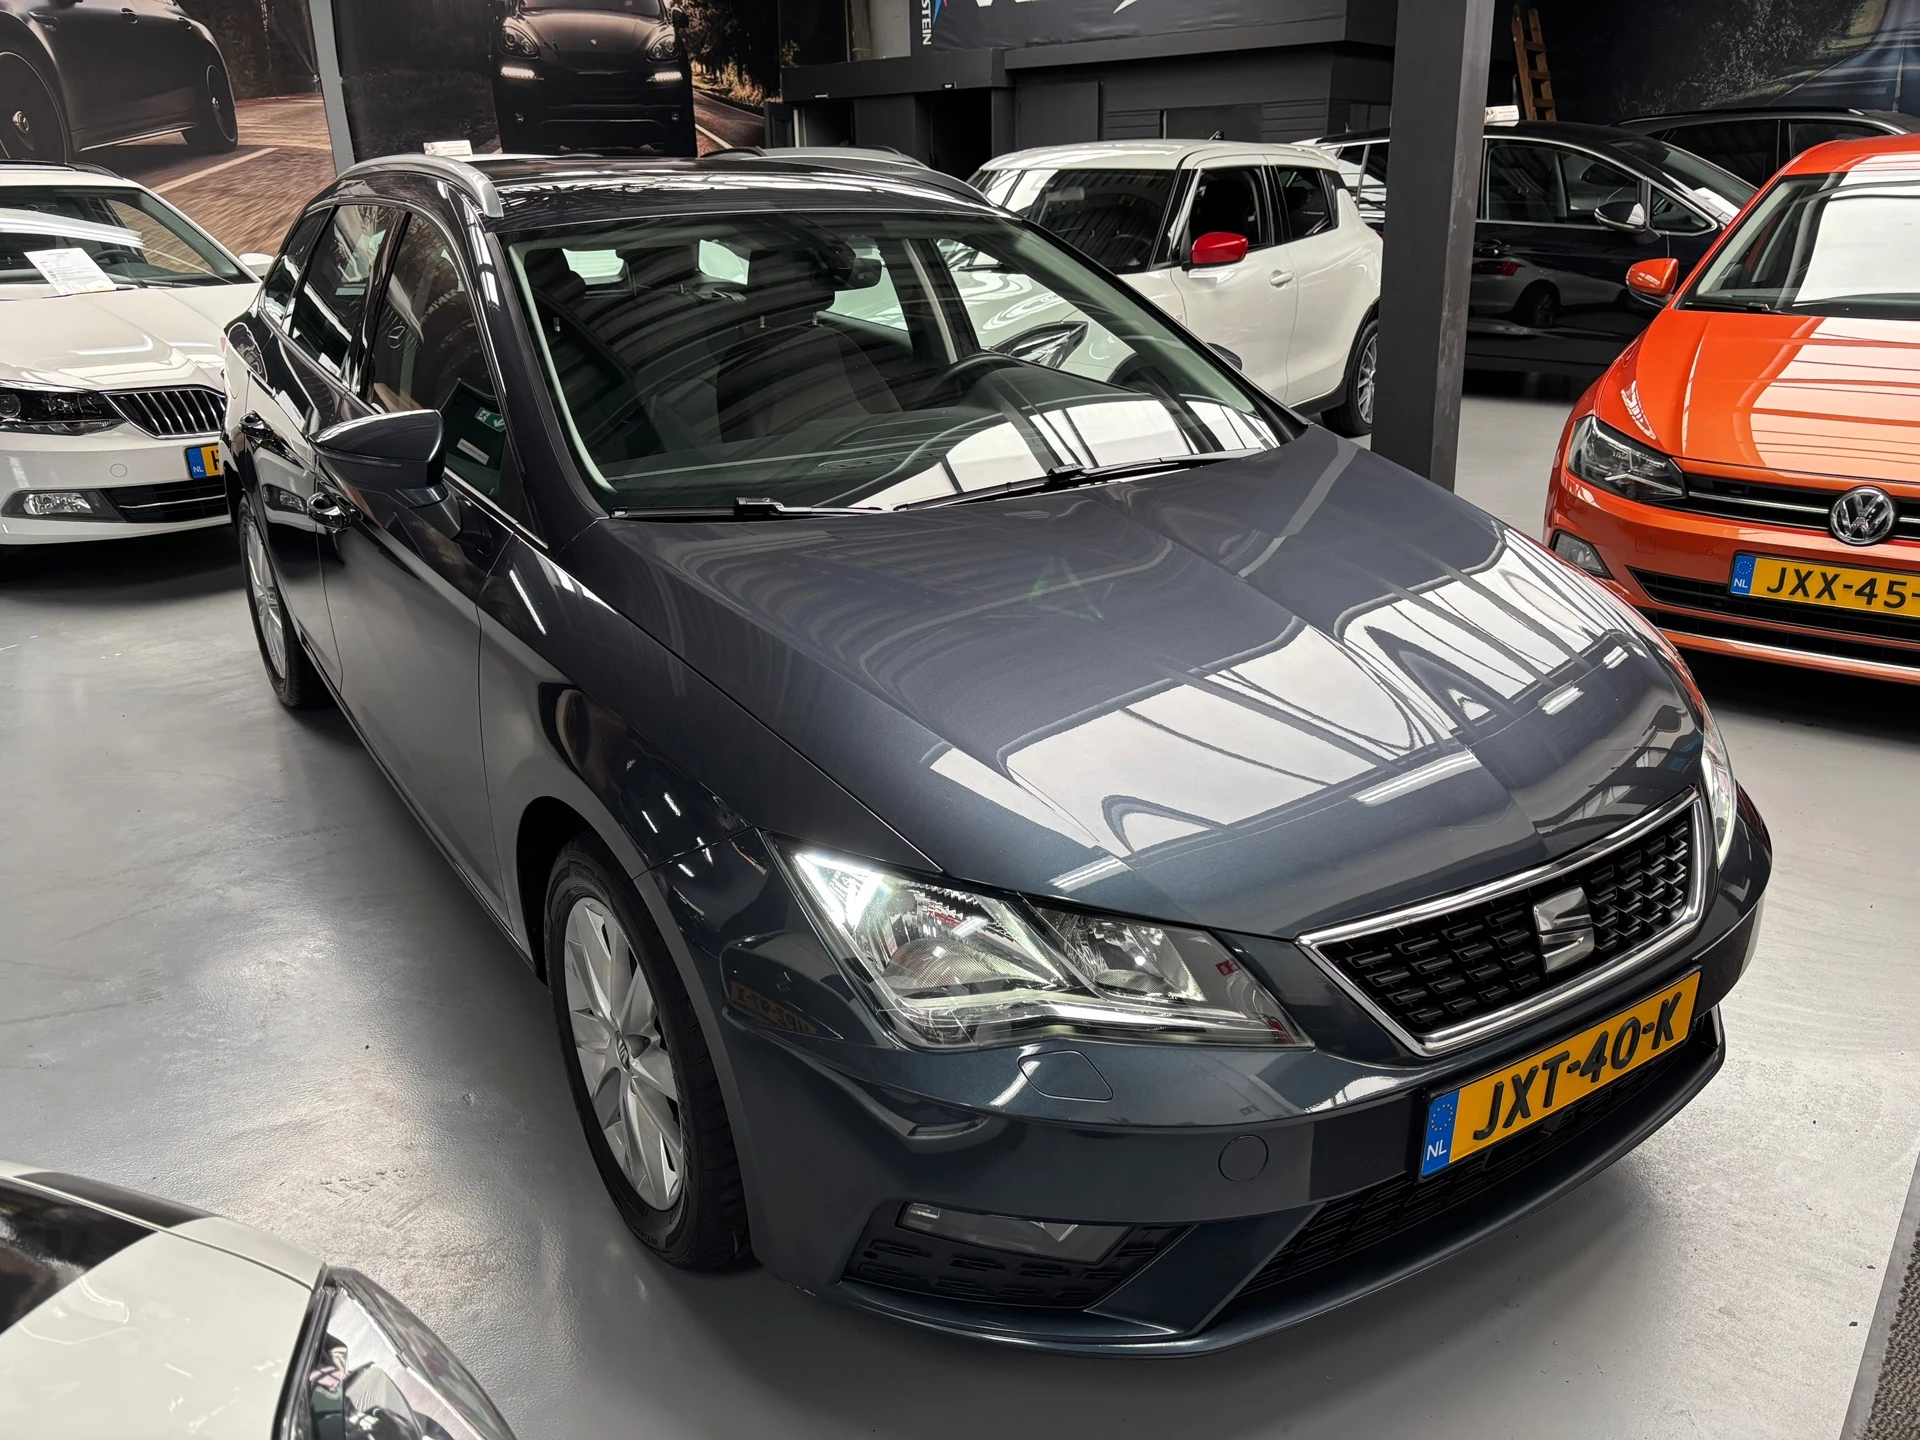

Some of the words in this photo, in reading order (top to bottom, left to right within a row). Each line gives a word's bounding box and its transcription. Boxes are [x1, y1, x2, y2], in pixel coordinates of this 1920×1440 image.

[192, 465, 205, 473] NL
[1733, 577, 1749, 589] NL
[1473, 991, 1682, 1140] JXT-40-K
[1426, 1139, 1447, 1161] NL
